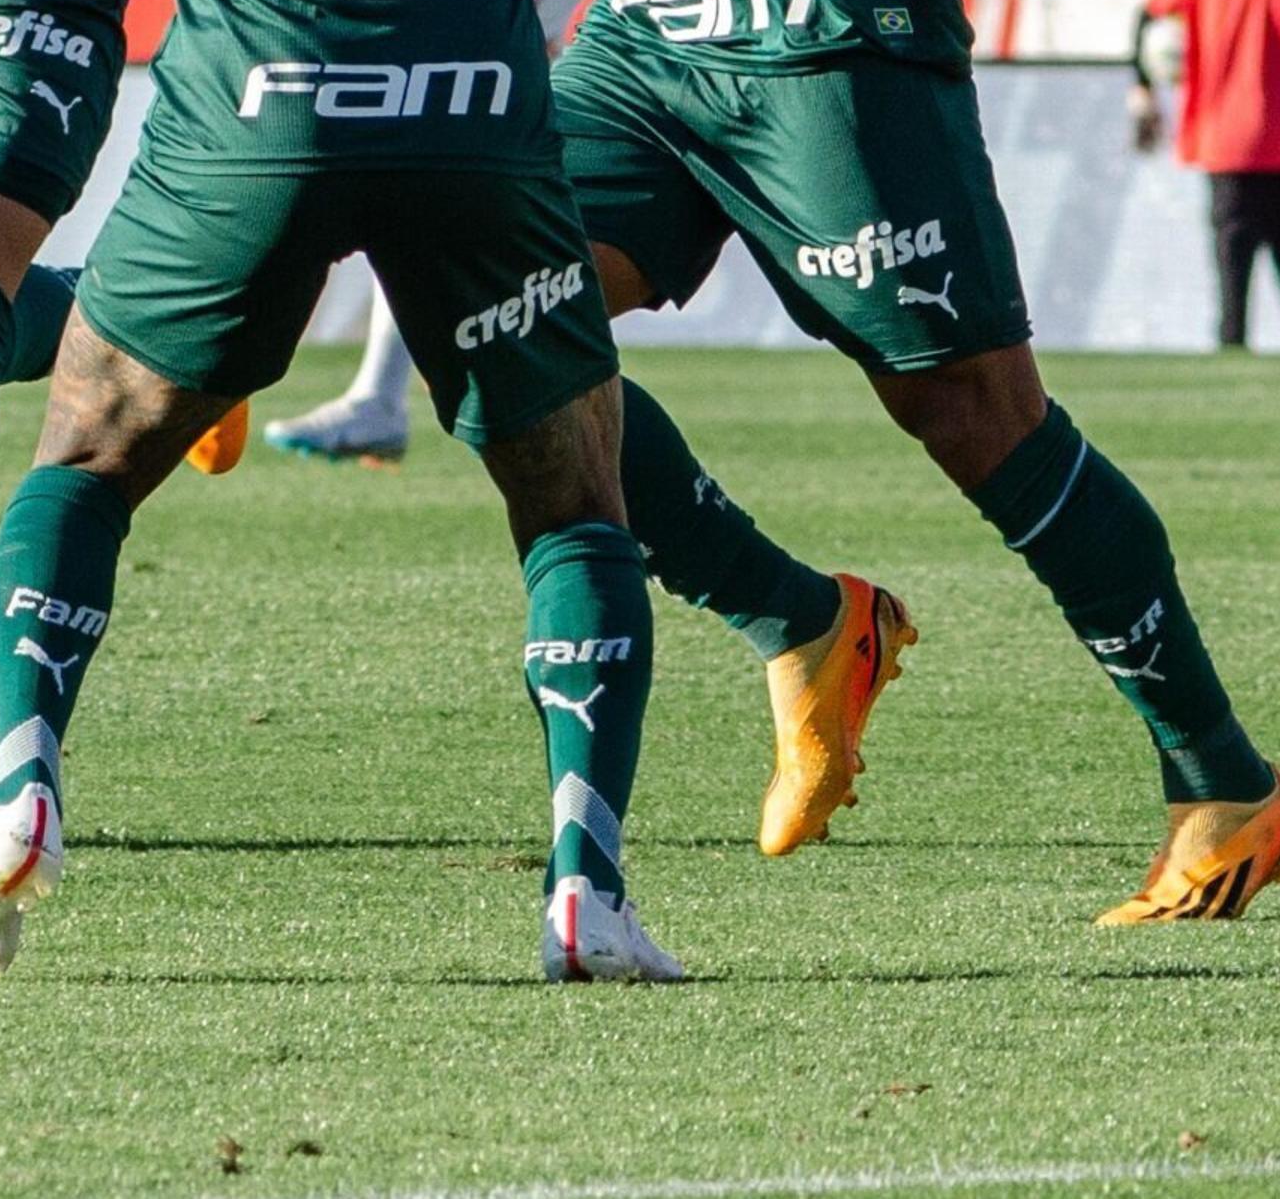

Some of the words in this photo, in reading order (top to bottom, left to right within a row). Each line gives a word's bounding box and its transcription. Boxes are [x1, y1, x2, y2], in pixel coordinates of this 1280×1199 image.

[236, 59, 512, 118] Fam
[797, 218, 946, 288] crefisa
[455, 262, 582, 350] crefisa
[5, 586, 108, 637] Fam
